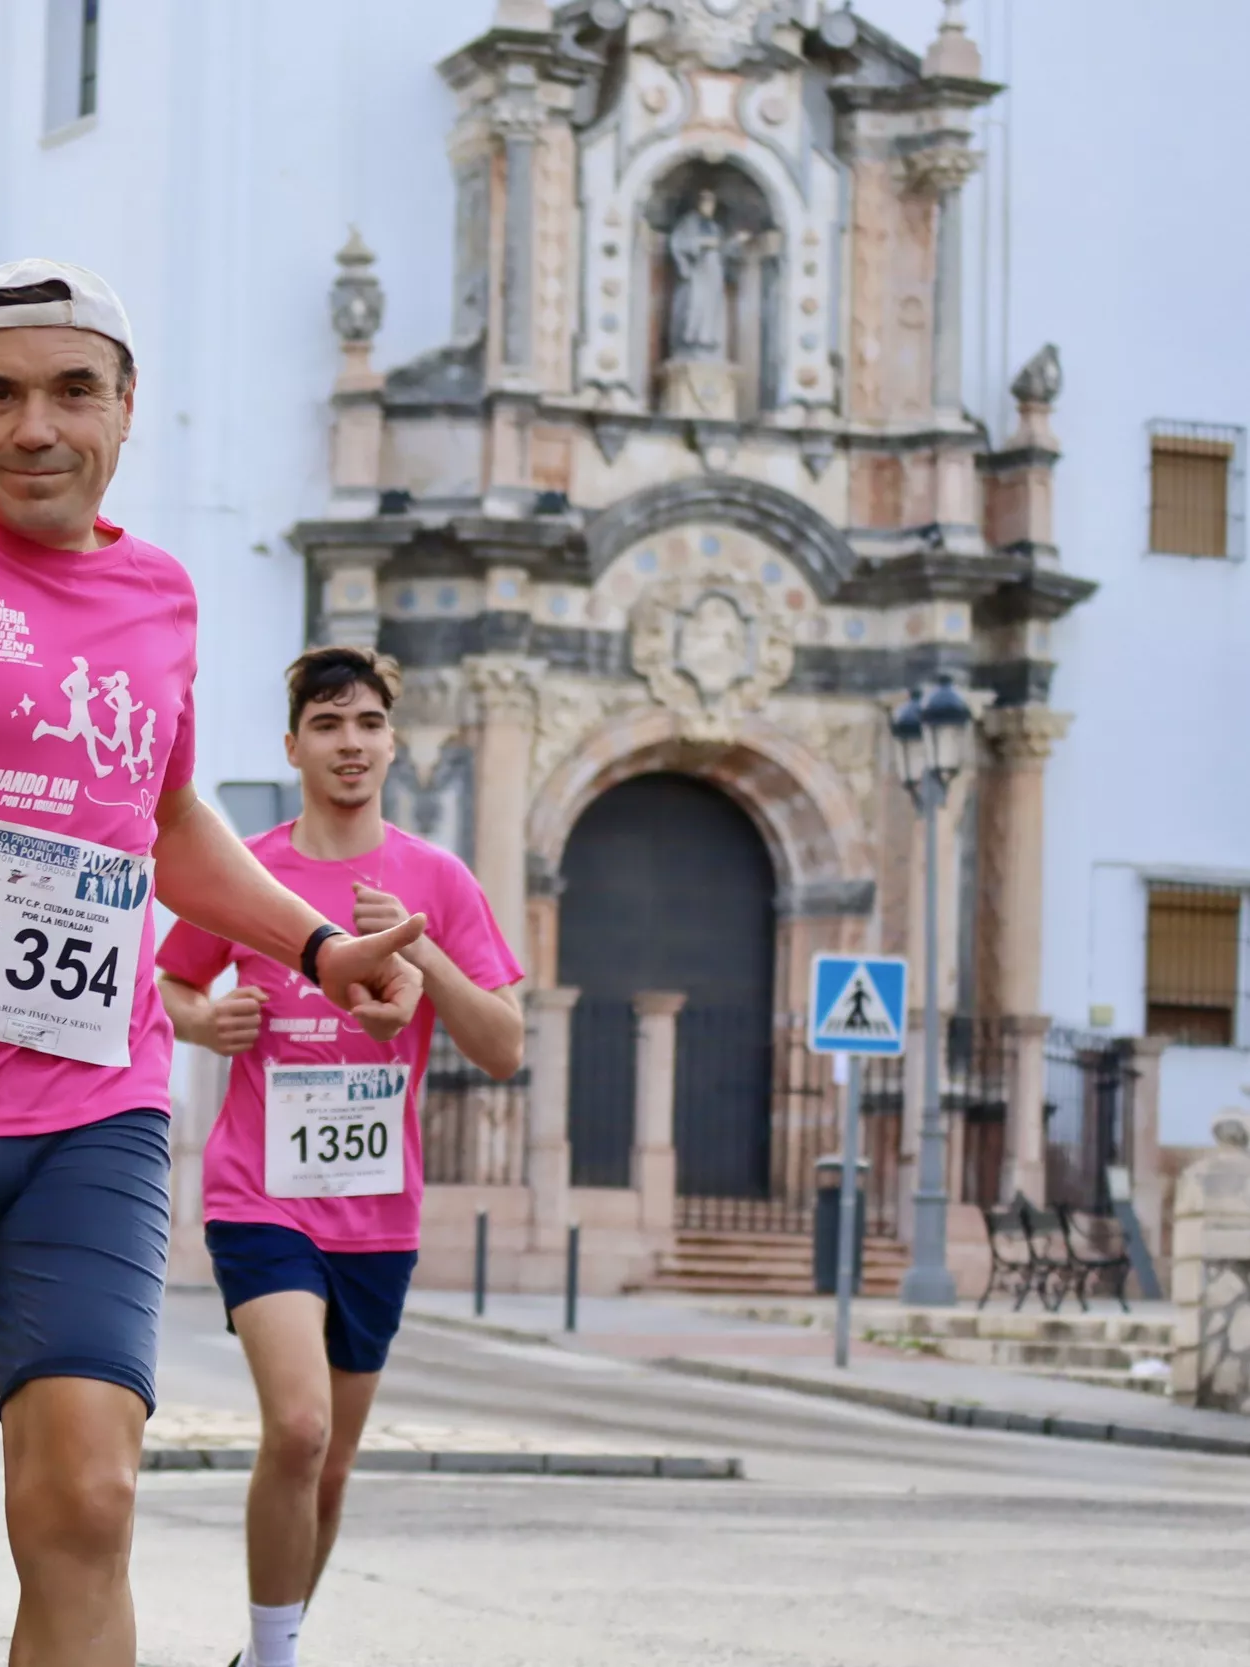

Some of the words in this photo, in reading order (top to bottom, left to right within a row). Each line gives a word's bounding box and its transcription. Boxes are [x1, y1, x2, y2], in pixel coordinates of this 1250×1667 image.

[48, 776, 79, 801] KM
[19, 797, 33, 809] LA
[32, 799, 75, 816] IGUALDAD
[10, 834, 67, 855] PROVINCIAL
[69, 846, 81, 859] DE
[19, 845, 80, 870] POPULARES
[19, 859, 31, 868] DE
[83, 851, 121, 879] 2024
[4, 894, 26, 905] XXV
[43, 903, 75, 916] CIUDAD
[75, 909, 86, 918] DE
[21, 911, 39, 922] POR
[40, 915, 52, 925] LA
[54, 918, 94, 933] IGUALDAD
[290, 1121, 388, 1164] 1350
